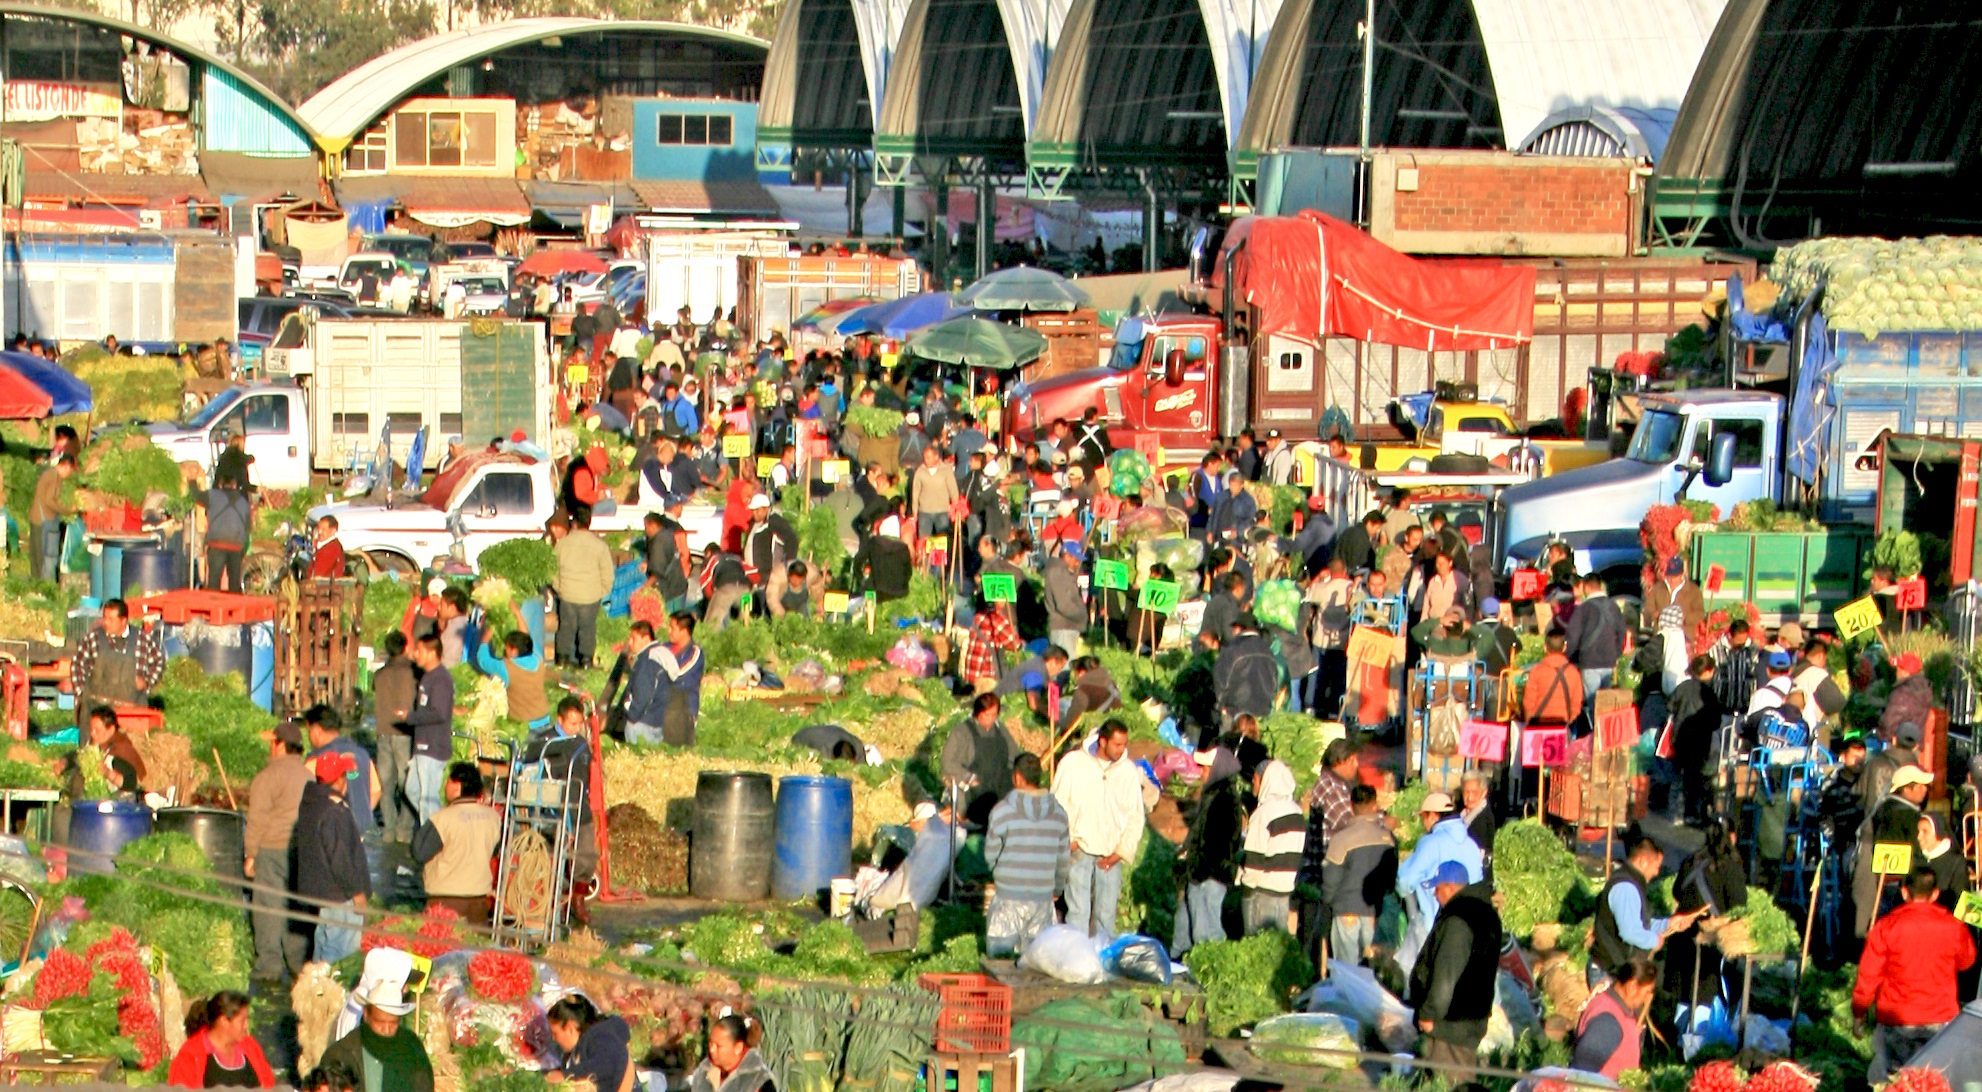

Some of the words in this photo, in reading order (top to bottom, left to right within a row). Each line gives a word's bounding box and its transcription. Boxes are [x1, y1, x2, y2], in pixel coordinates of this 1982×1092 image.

[1149, 590, 1167, 607] 10
[1902, 589, 1915, 605] 15
[1847, 612, 1869, 634] 20
[1468, 734, 1491, 755] 10
